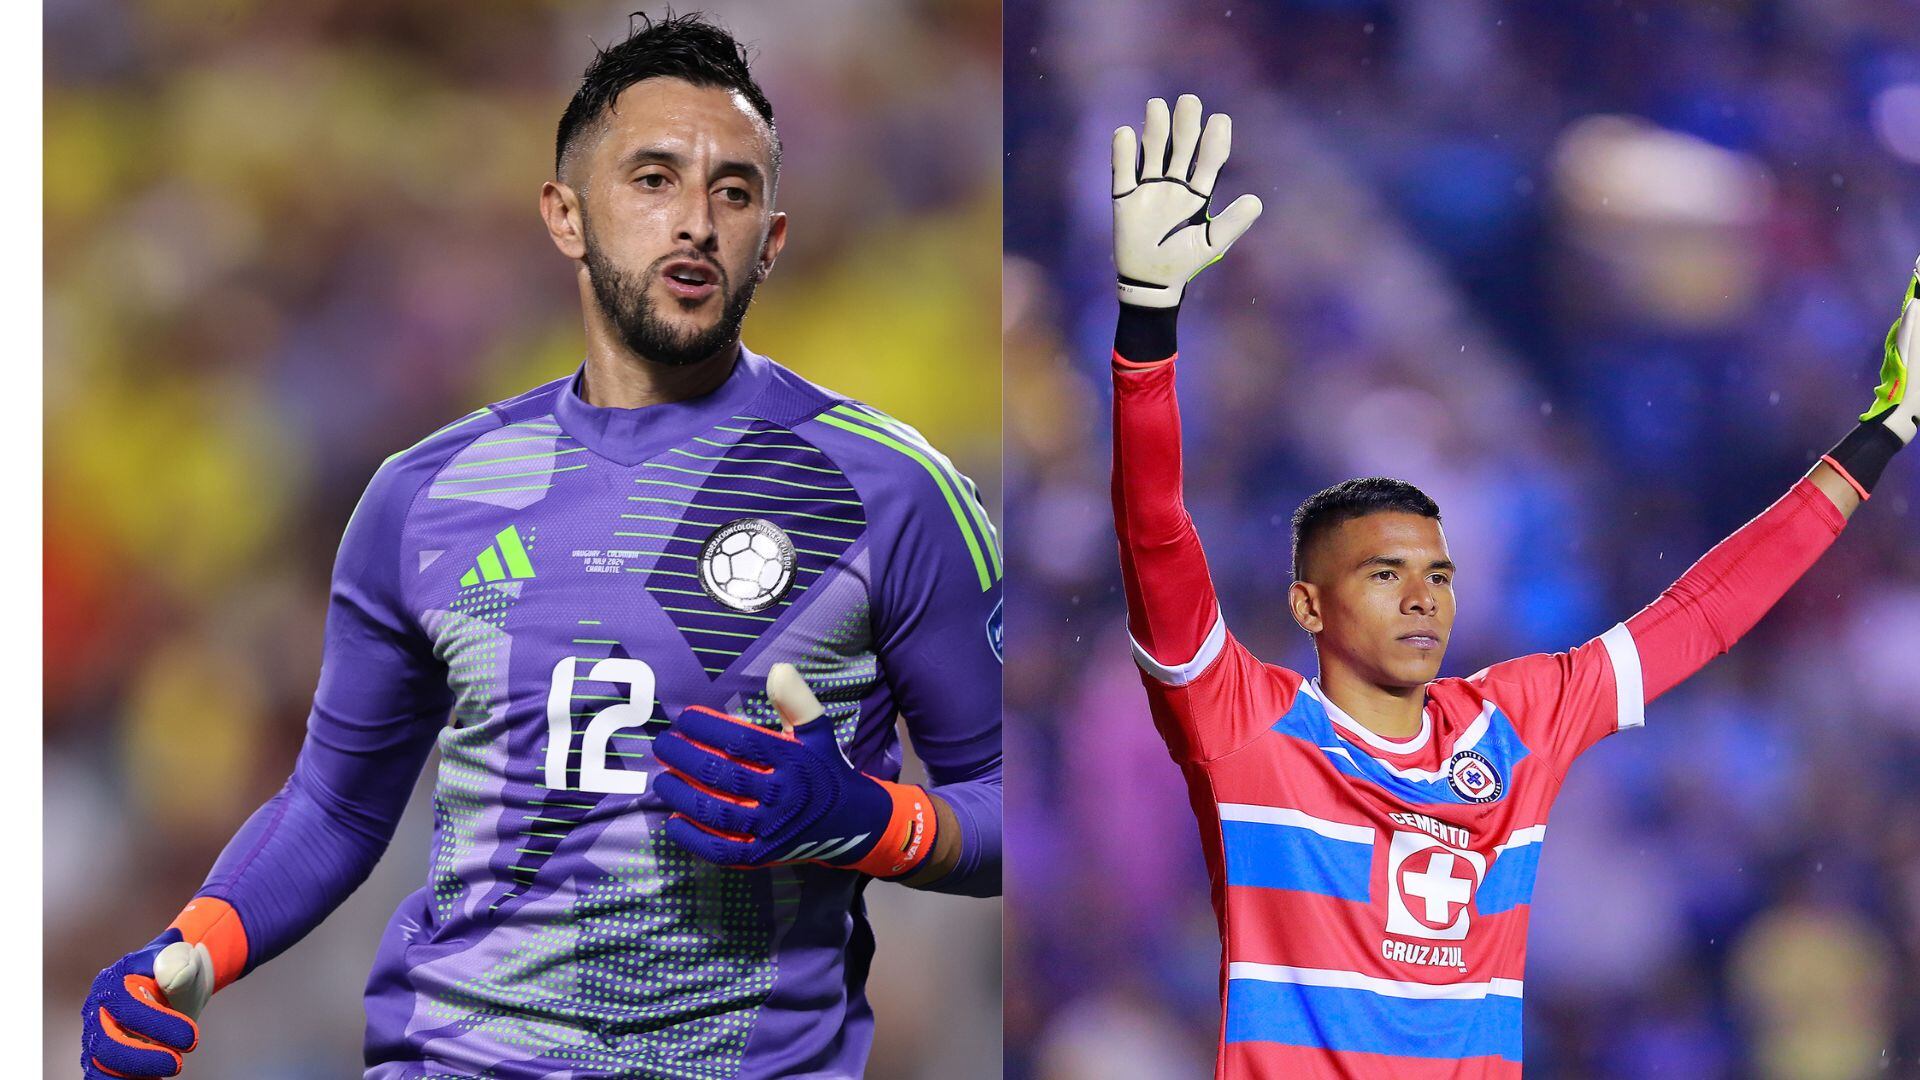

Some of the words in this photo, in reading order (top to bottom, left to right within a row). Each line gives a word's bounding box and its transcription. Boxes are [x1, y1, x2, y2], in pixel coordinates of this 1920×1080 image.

[585, 565, 621, 574] CHARLOTTE
[544, 655, 656, 795] 12
[903, 802, 924, 861] VARGAS
[1388, 812, 1470, 849] CEMENTO
[1381, 939, 1431, 966] CRUZ
[1428, 946, 1466, 967] AZUL
